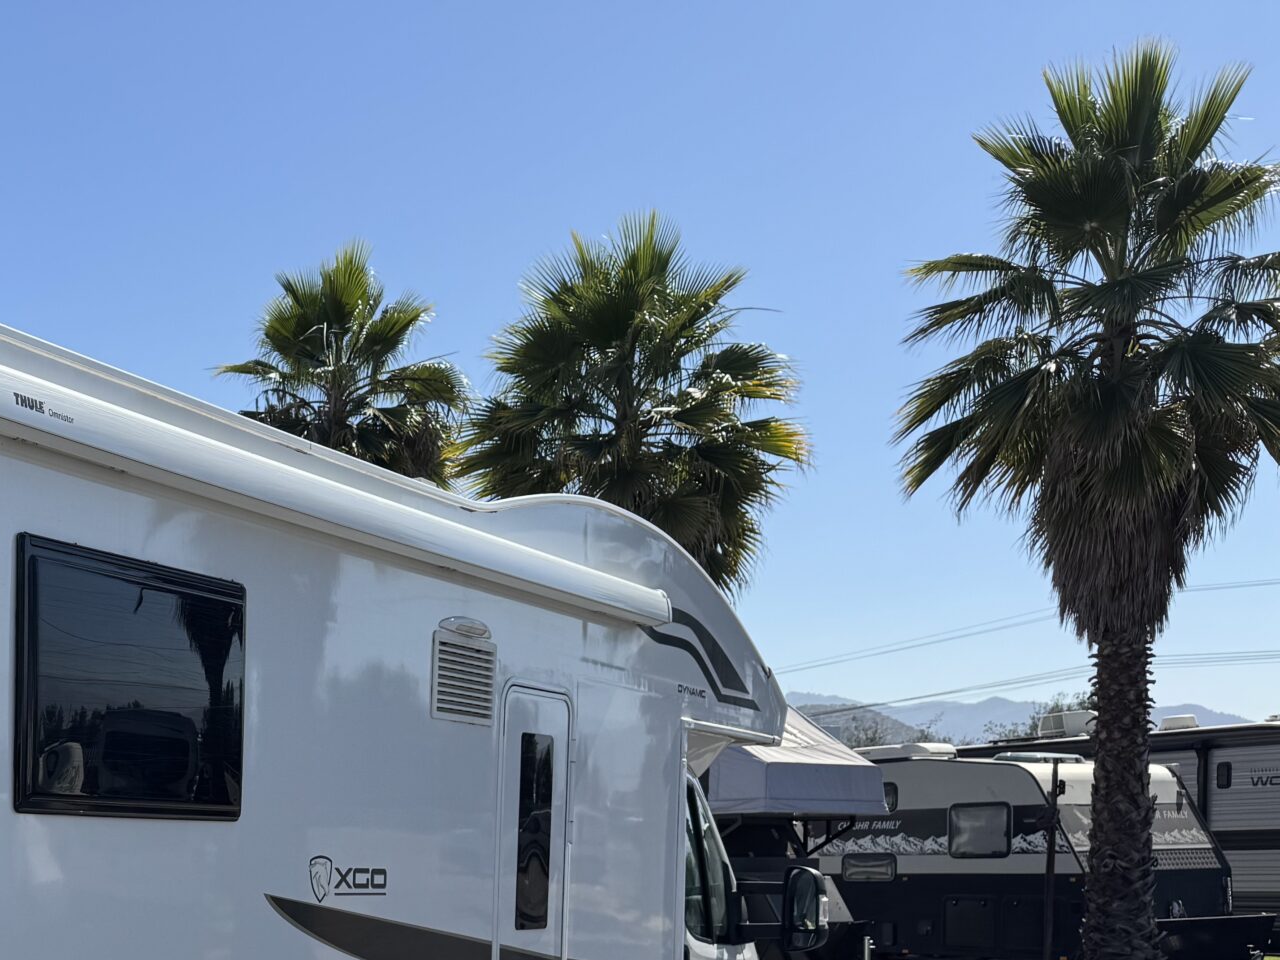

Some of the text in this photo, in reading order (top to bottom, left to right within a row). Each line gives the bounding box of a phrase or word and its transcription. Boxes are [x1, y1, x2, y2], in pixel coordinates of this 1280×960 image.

[13, 392, 45, 414] THULE
[677, 684, 706, 699] DYNAMIC
[871, 820, 901, 830] FAMILY
[334, 867, 387, 889] XGO
